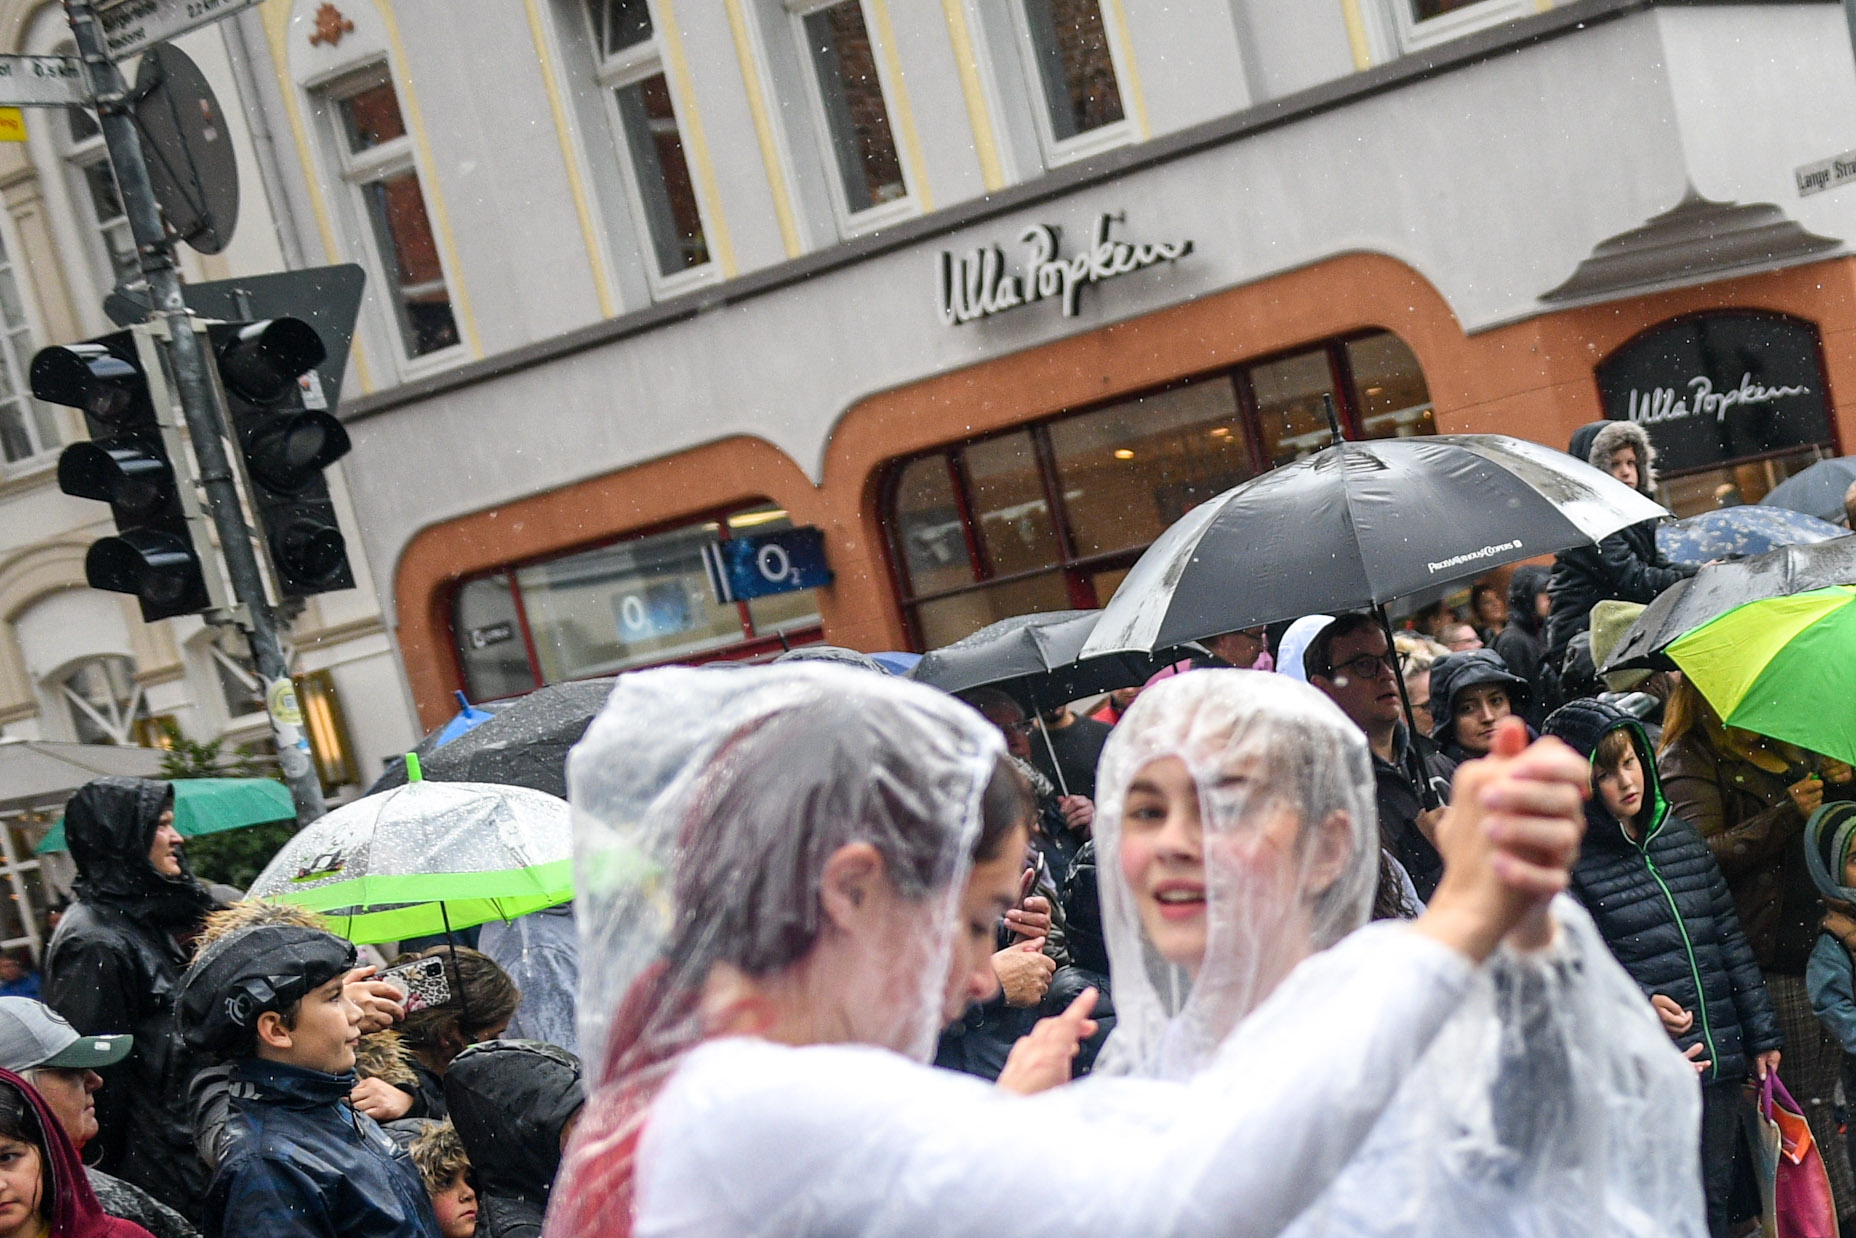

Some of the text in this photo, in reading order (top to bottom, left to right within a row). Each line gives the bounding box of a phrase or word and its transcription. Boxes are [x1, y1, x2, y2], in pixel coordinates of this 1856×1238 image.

[934, 214, 1193, 326] Ulla Popken
[1628, 371, 1803, 424] Ulla Popken
